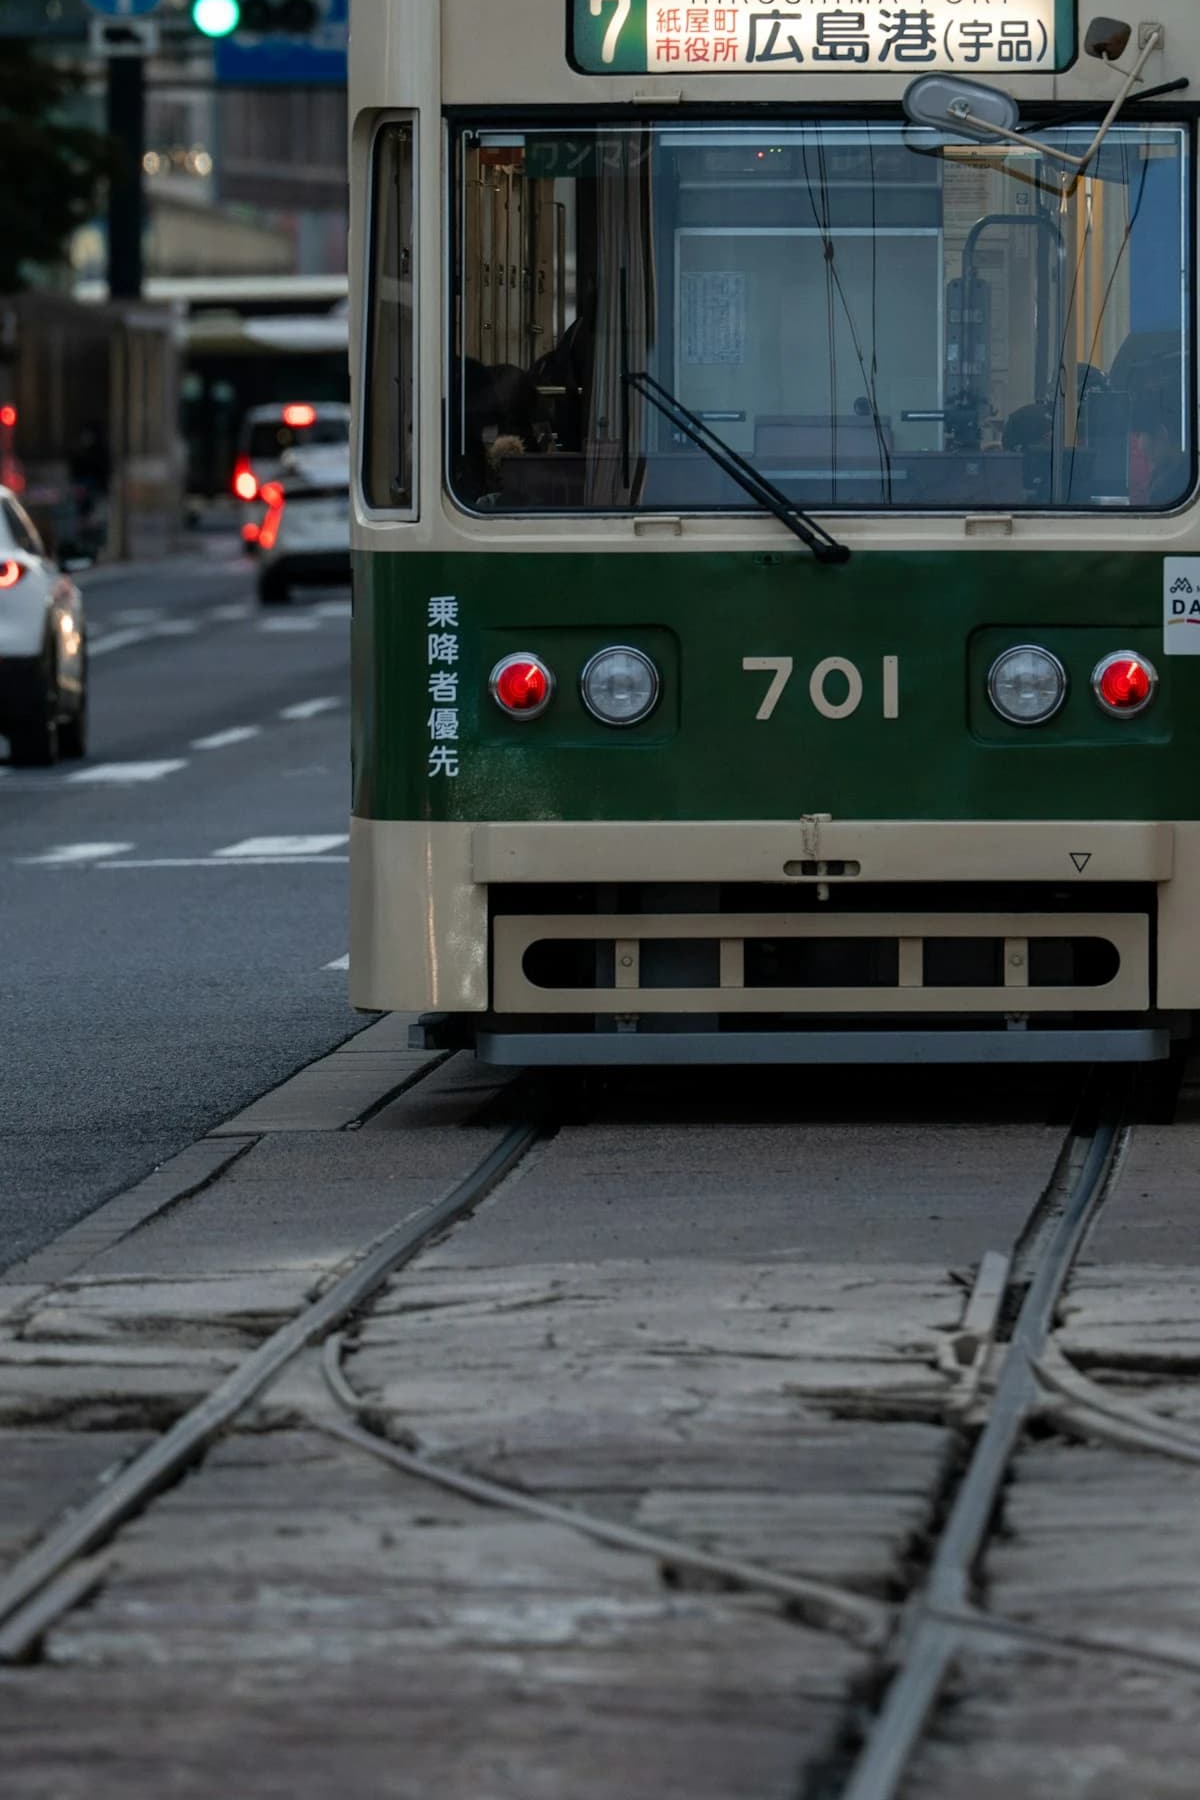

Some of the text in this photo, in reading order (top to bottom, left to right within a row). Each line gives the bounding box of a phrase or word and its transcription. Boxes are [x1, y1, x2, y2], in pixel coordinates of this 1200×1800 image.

[656, 8, 739, 33] 紙屋町
[656, 36, 739, 63] 市役所
[531, 140, 650, 170] ワンマン
[427, 595, 459, 778] 乗降者優先
[742, 655, 899, 720] 701
